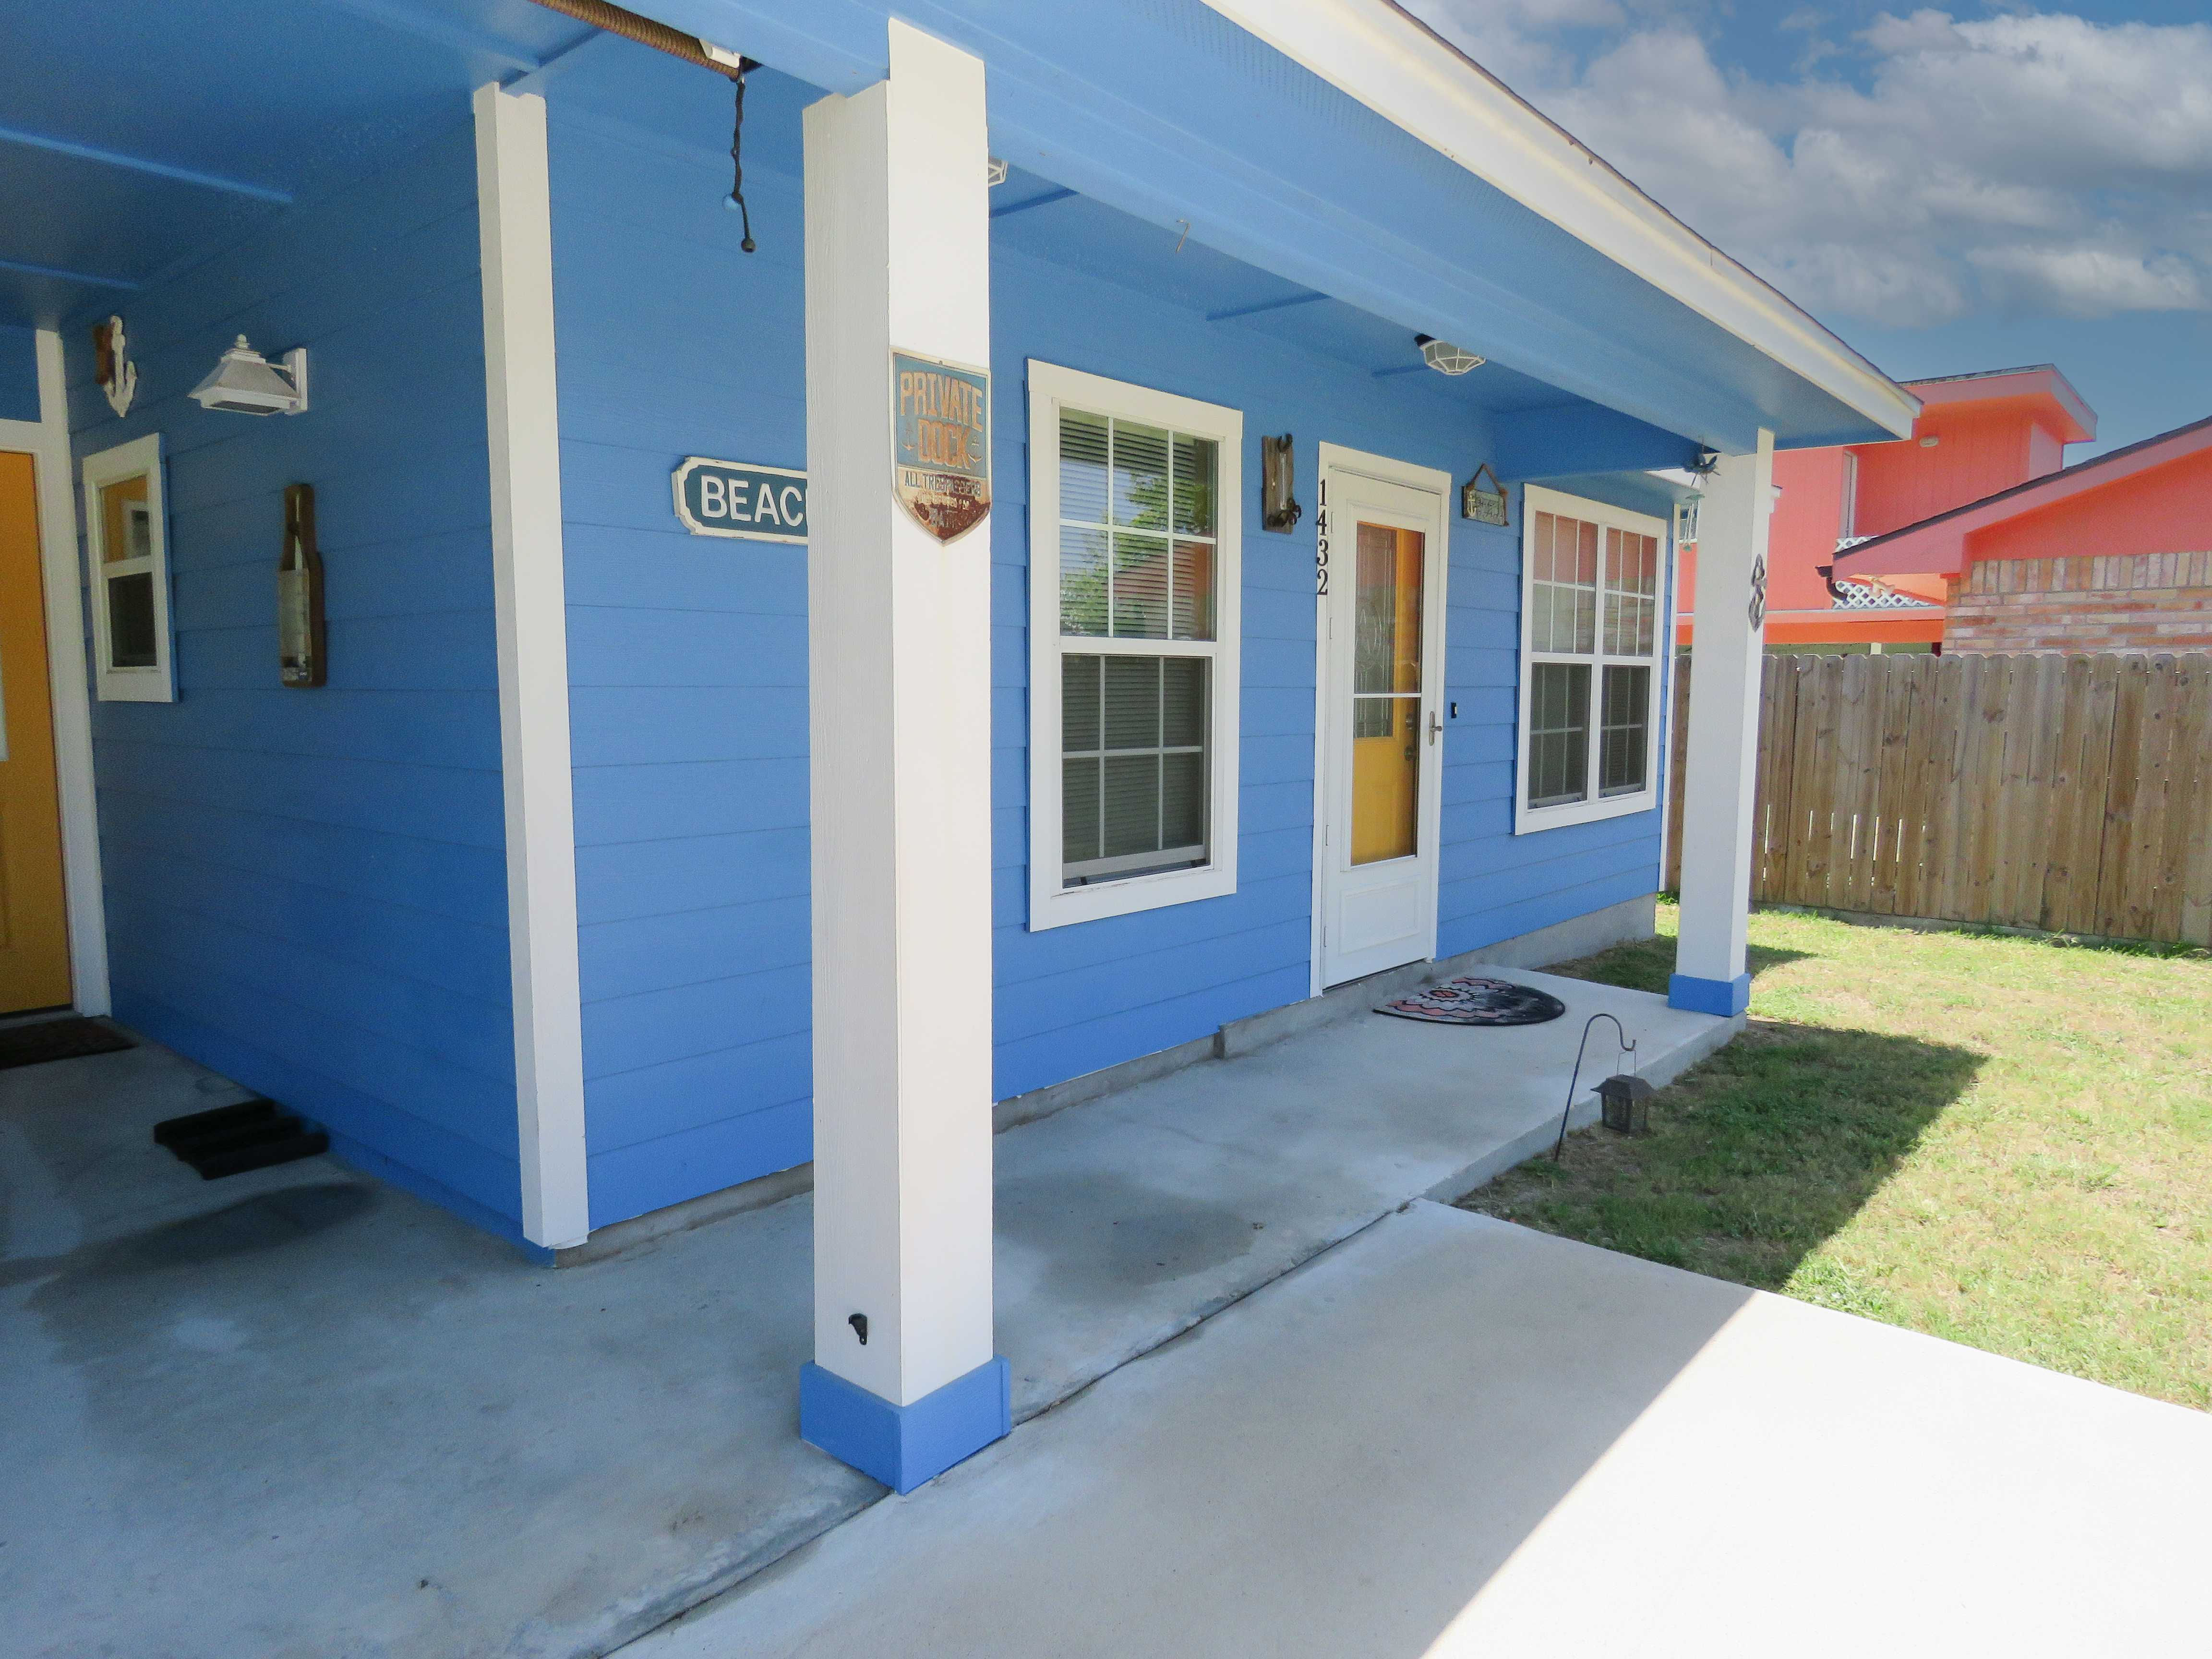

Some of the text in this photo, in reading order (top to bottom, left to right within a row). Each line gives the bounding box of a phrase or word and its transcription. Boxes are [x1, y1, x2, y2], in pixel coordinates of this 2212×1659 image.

[900, 372, 983, 432] PRIVATE
[918, 418, 971, 469] DOCK
[701, 475, 808, 527] BEAC
[905, 471, 921, 488] ALL
[1316, 479, 1328, 595] 1432
